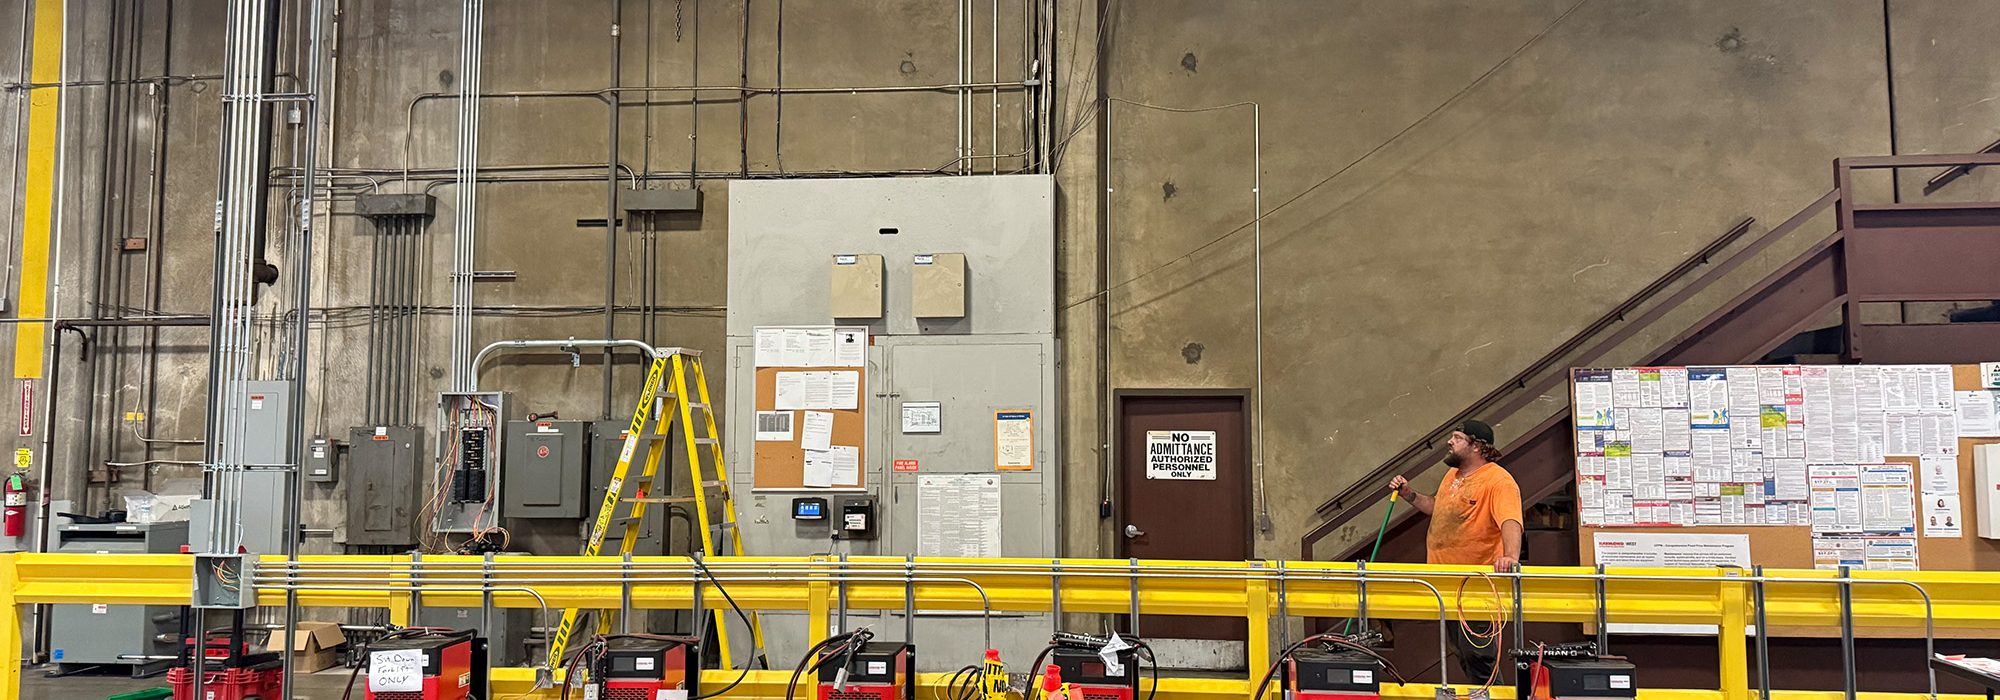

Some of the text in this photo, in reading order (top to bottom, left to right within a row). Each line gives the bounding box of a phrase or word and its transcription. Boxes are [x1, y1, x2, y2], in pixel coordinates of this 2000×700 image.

[1172, 433, 1189, 442] NO
[1150, 443, 1213, 455] ADMITTANCE
[1151, 455, 1213, 463] AUTHORIZED
[1152, 463, 1210, 471] PERSONNEL
[376, 654, 416, 664] Sit Down
[378, 675, 409, 686] ONLY
